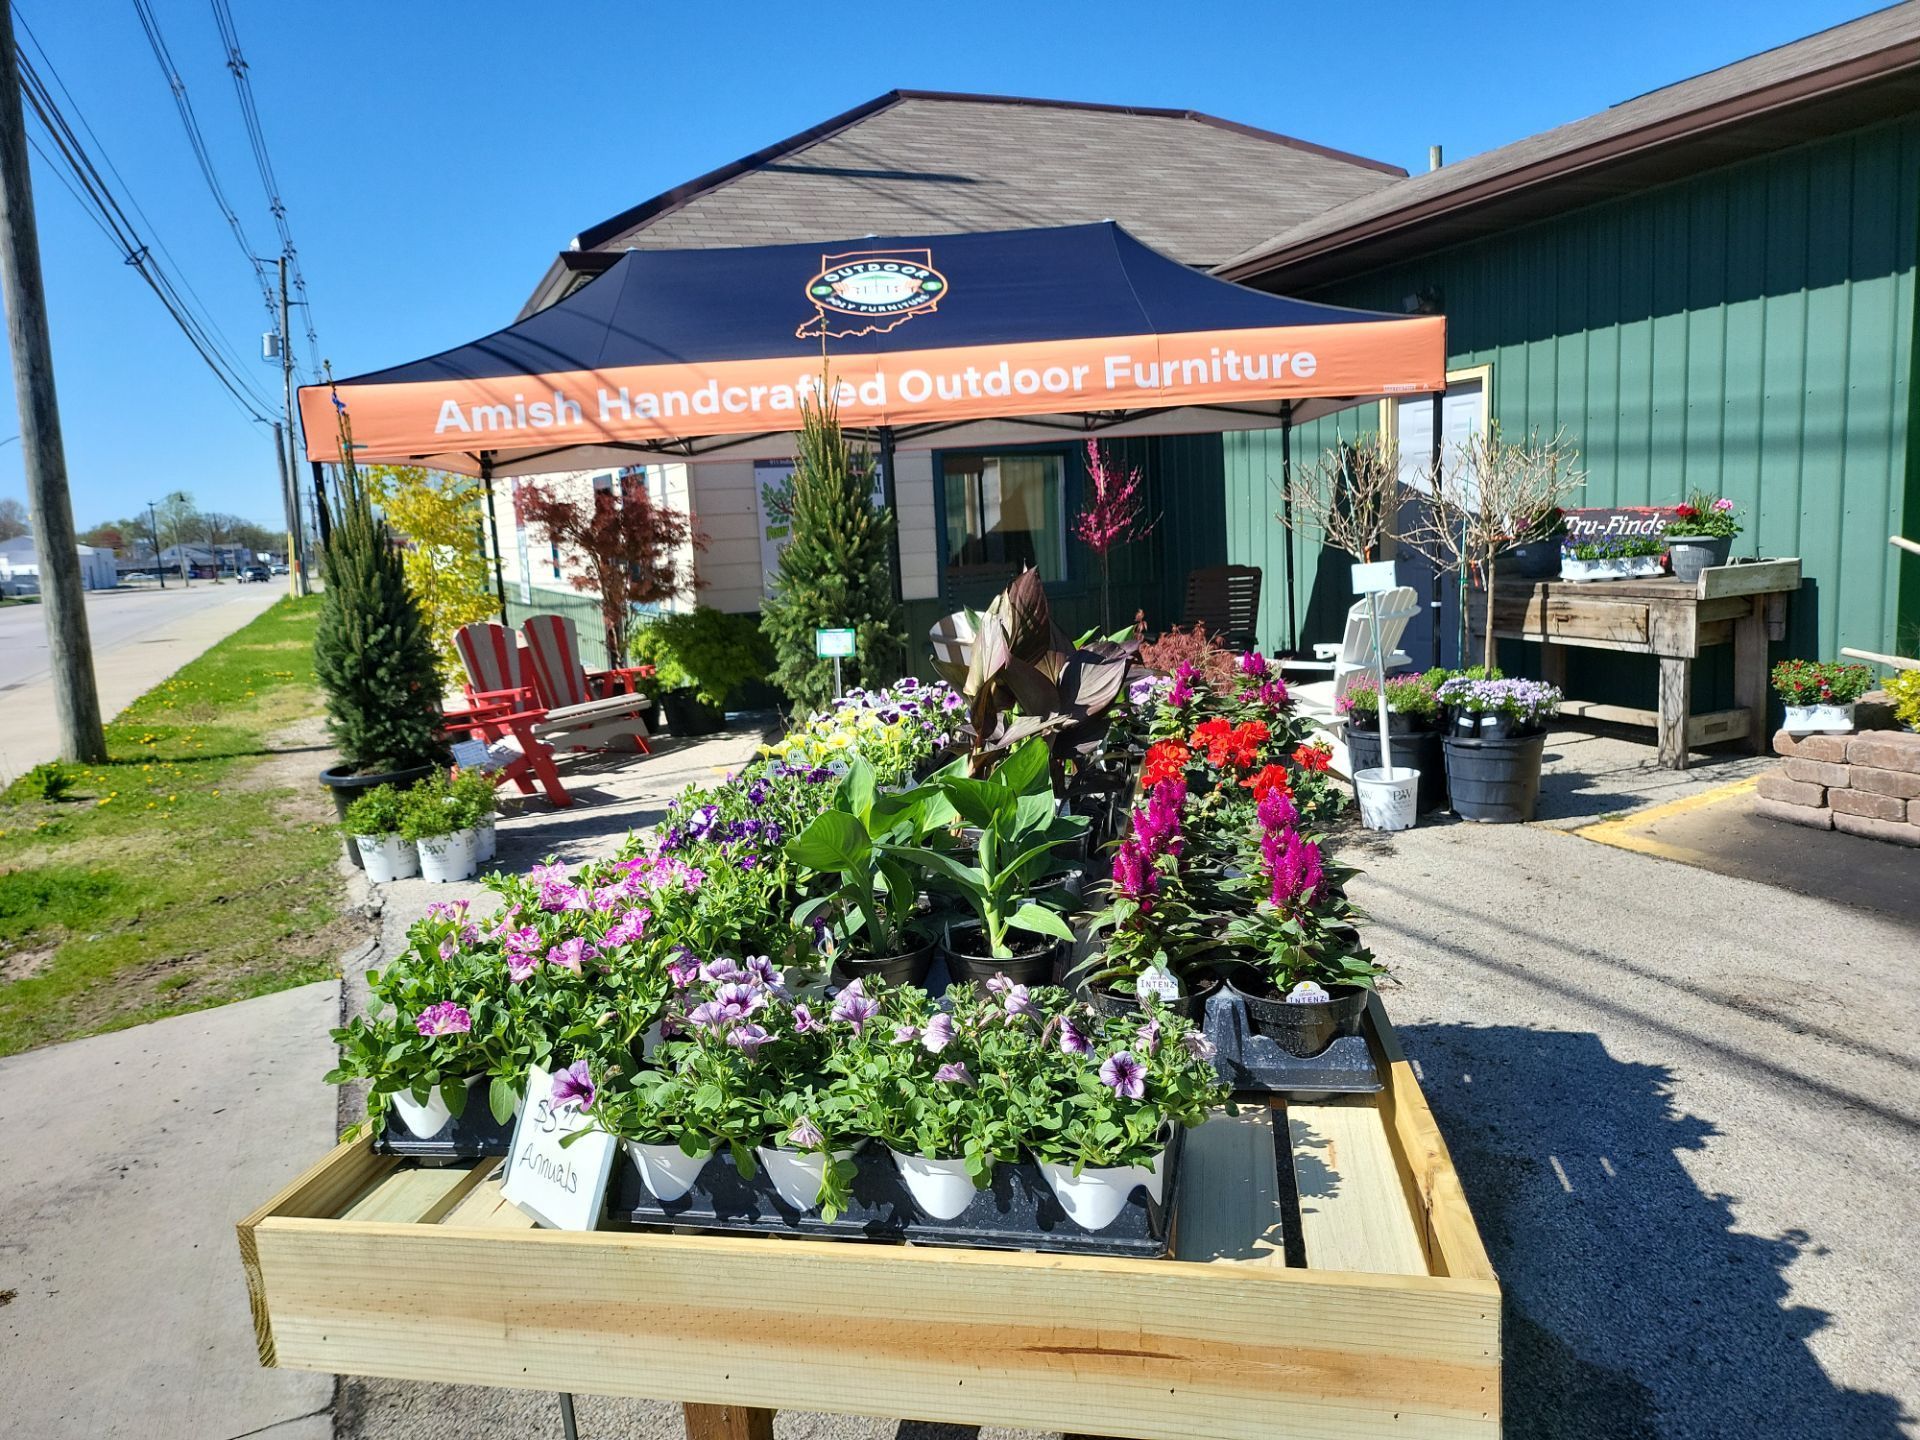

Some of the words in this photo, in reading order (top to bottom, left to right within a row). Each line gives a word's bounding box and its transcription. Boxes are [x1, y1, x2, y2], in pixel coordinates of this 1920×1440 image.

[824, 263, 930, 282] OUTDOOR
[860, 293, 930, 312] FURNITURE
[434, 390, 583, 435] Amish
[597, 372, 887, 423] Handcrafted
[898, 361, 1089, 403] Outdoor
[1104, 346, 1318, 390] Furniture
[1564, 512, 1667, 535] Tru-Finds
[519, 1142, 577, 1194] Annuals
